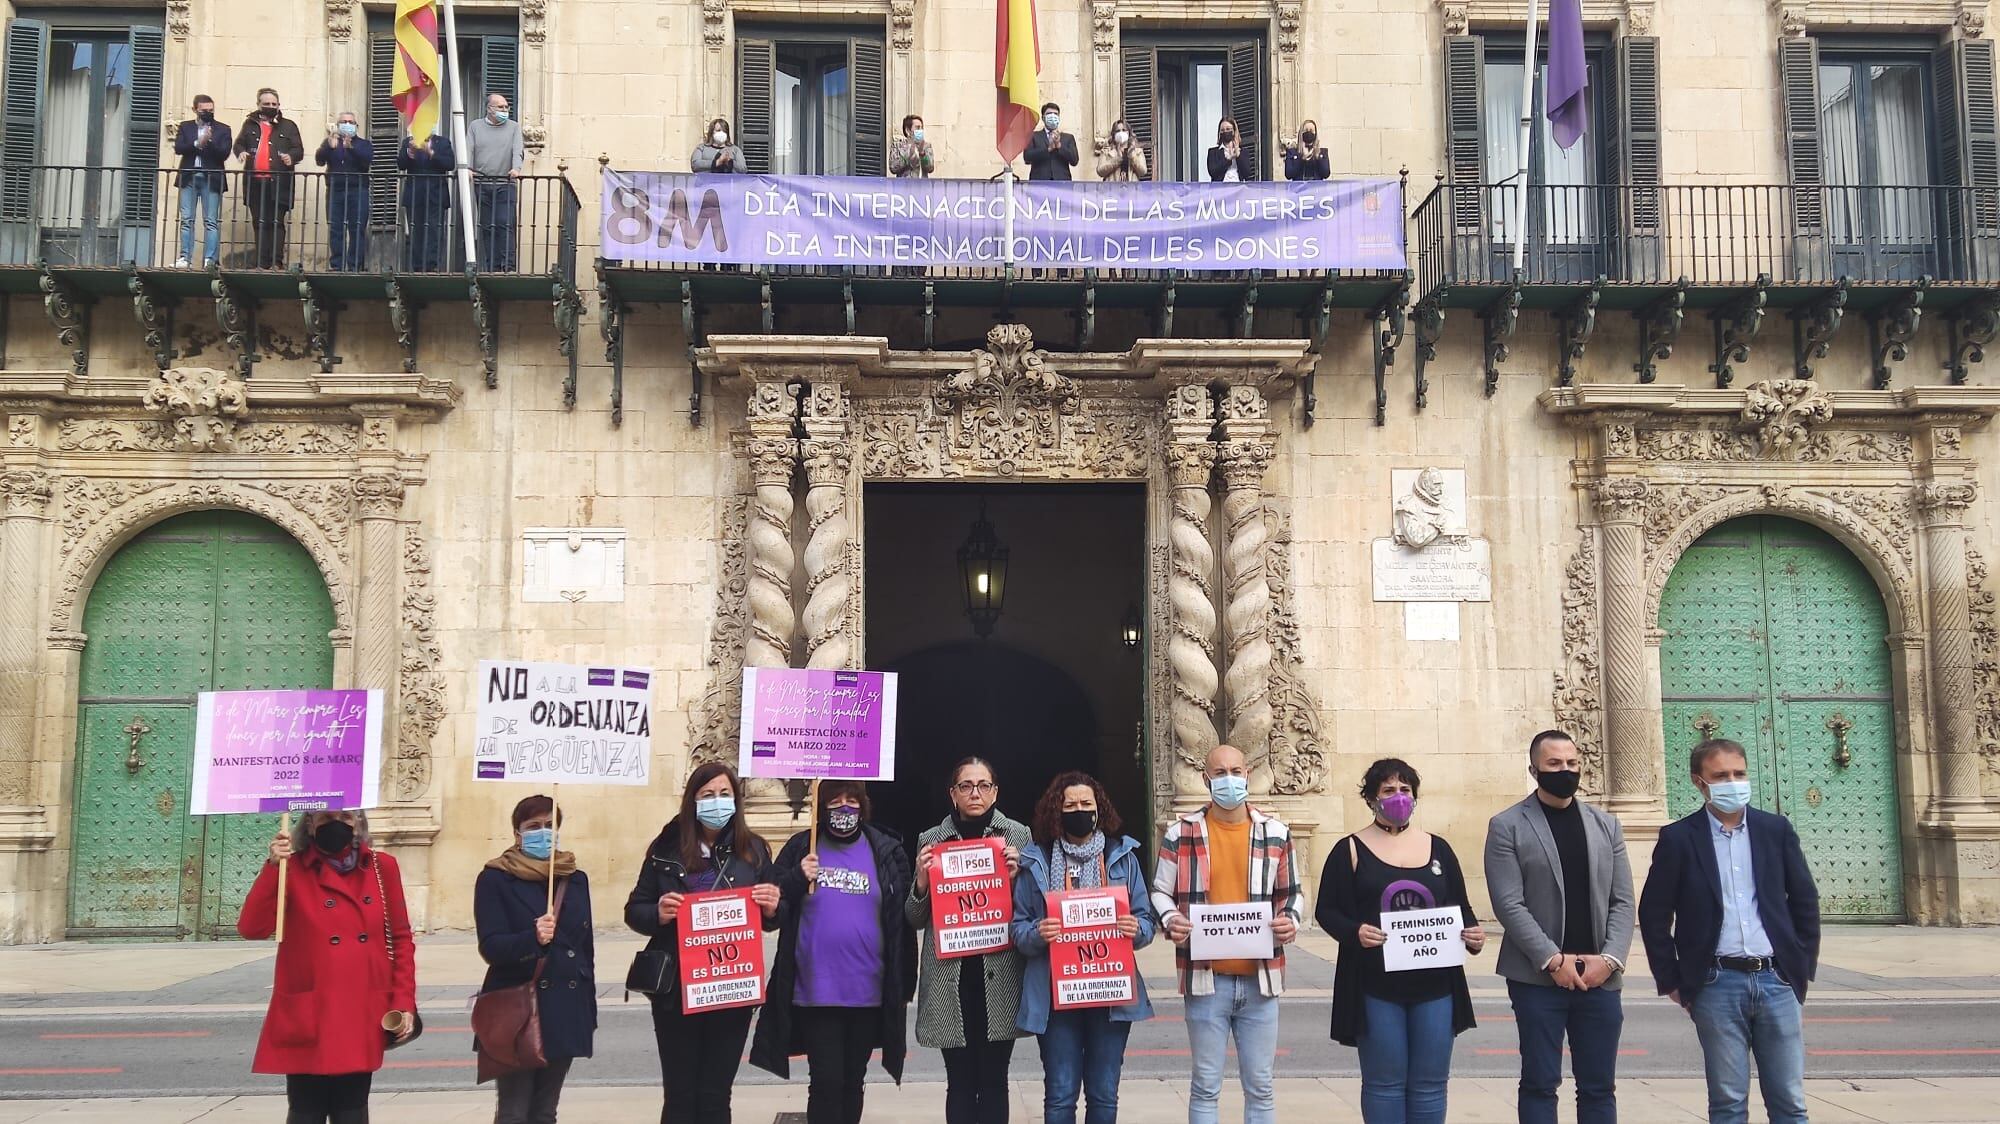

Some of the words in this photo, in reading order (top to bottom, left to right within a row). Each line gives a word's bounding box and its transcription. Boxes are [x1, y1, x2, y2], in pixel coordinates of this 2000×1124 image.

[744, 184, 800, 217] DÍA
[811, 191, 1071, 221] INTERNACIONAL
[1081, 198, 1118, 221] DE
[1128, 199, 1185, 222] LAS
[1195, 195, 1335, 222] MUJERES
[607, 187, 728, 252] 8M
[766, 231, 823, 257] DIA
[833, 233, 1093, 262] INTERNACIONAL
[1103, 237, 1141, 262] DE
[1150, 236, 1204, 262] LES
[1215, 235, 1320, 262] DONES
[488, 667, 528, 703] NO
[536, 676, 550, 692] A
[555, 676, 578, 694] LA
[767, 680, 776, 699] de
[779, 679, 820, 705] Marzo
[824, 688, 858, 705] siempre
[860, 681, 880, 703] Las
[216, 704, 223, 716] 8
[226, 699, 238, 723] de
[294, 704, 338, 726] sempre
[339, 694, 366, 721] Les
[531, 699, 650, 737] ORDENANZA
[763, 705, 800, 724] mujeres
[801, 706, 819, 723] por
[820, 701, 831, 720] la
[832, 701, 870, 726] igualdad
[492, 717, 518, 735] DE
[767, 726, 847, 738] MANIFESTACIÓN
[849, 729, 855, 738] 8
[857, 730, 868, 738] de
[226, 724, 257, 749] dones
[260, 730, 284, 752] per
[285, 721, 300, 746] la
[303, 720, 359, 753] igualtat
[788, 741, 823, 750] MARZO
[825, 742, 847, 751] 2022
[212, 753, 300, 767] MANIFESTACIÓ
[302, 755, 310, 765] 8
[312, 754, 324, 764] de
[327, 754, 362, 767] MARÇ
[476, 736, 498, 757] LA
[506, 736, 645, 777] VERGÜENZA
[273, 770, 300, 780] 2022
[288, 800, 328, 811] feminista
[965, 857, 991, 870] PSOE
[936, 878, 1003, 894] SOBREVIVIR
[958, 890, 989, 914] NO
[716, 908, 743, 921] PSOE
[944, 913, 959, 925] ES
[962, 909, 1003, 923] DELITO
[1086, 907, 1113, 919] PSOE
[1201, 911, 1263, 923] FEMINISME
[1203, 927, 1225, 936] TOT
[1228, 925, 1261, 936] L'ANY
[1391, 916, 1454, 930] FEMINISMO
[685, 929, 755, 947] SOBREVIVIR
[944, 932, 953, 941] NO
[954, 931, 960, 940] A
[959, 930, 968, 939] LA
[968, 925, 1005, 938] ORDENANZA
[1056, 929, 1124, 943] SOBREVIVIR
[1400, 933, 1432, 944] TODO
[1435, 932, 1447, 941] EL
[948, 941, 957, 951] DE
[957, 940, 966, 949] LA
[966, 936, 1002, 949] VERGÜENZA
[1413, 945, 1438, 957] AÑO
[707, 943, 740, 967] NO
[1077, 941, 1110, 965] NO
[692, 968, 708, 979] ES
[711, 962, 754, 977] DELITO
[1063, 964, 1078, 976] ES
[1082, 961, 1124, 974] DELITO
[691, 986, 701, 995] NO
[702, 986, 708, 994] A
[708, 985, 717, 993] LA
[717, 979, 756, 993] ORDENANZA
[1062, 983, 1072, 992] NO
[1072, 983, 1078, 991] A
[1078, 982, 1087, 991] LA
[1088, 979, 1127, 991] ORDENANZA
[696, 996, 705, 1005] DE
[705, 995, 715, 1004] LA
[715, 990, 753, 1003] VERGÜENZA
[1066, 993, 1076, 1002] DE
[1076, 992, 1085, 1001] LA
[1086, 989, 1124, 1001] VERGÜENZA
